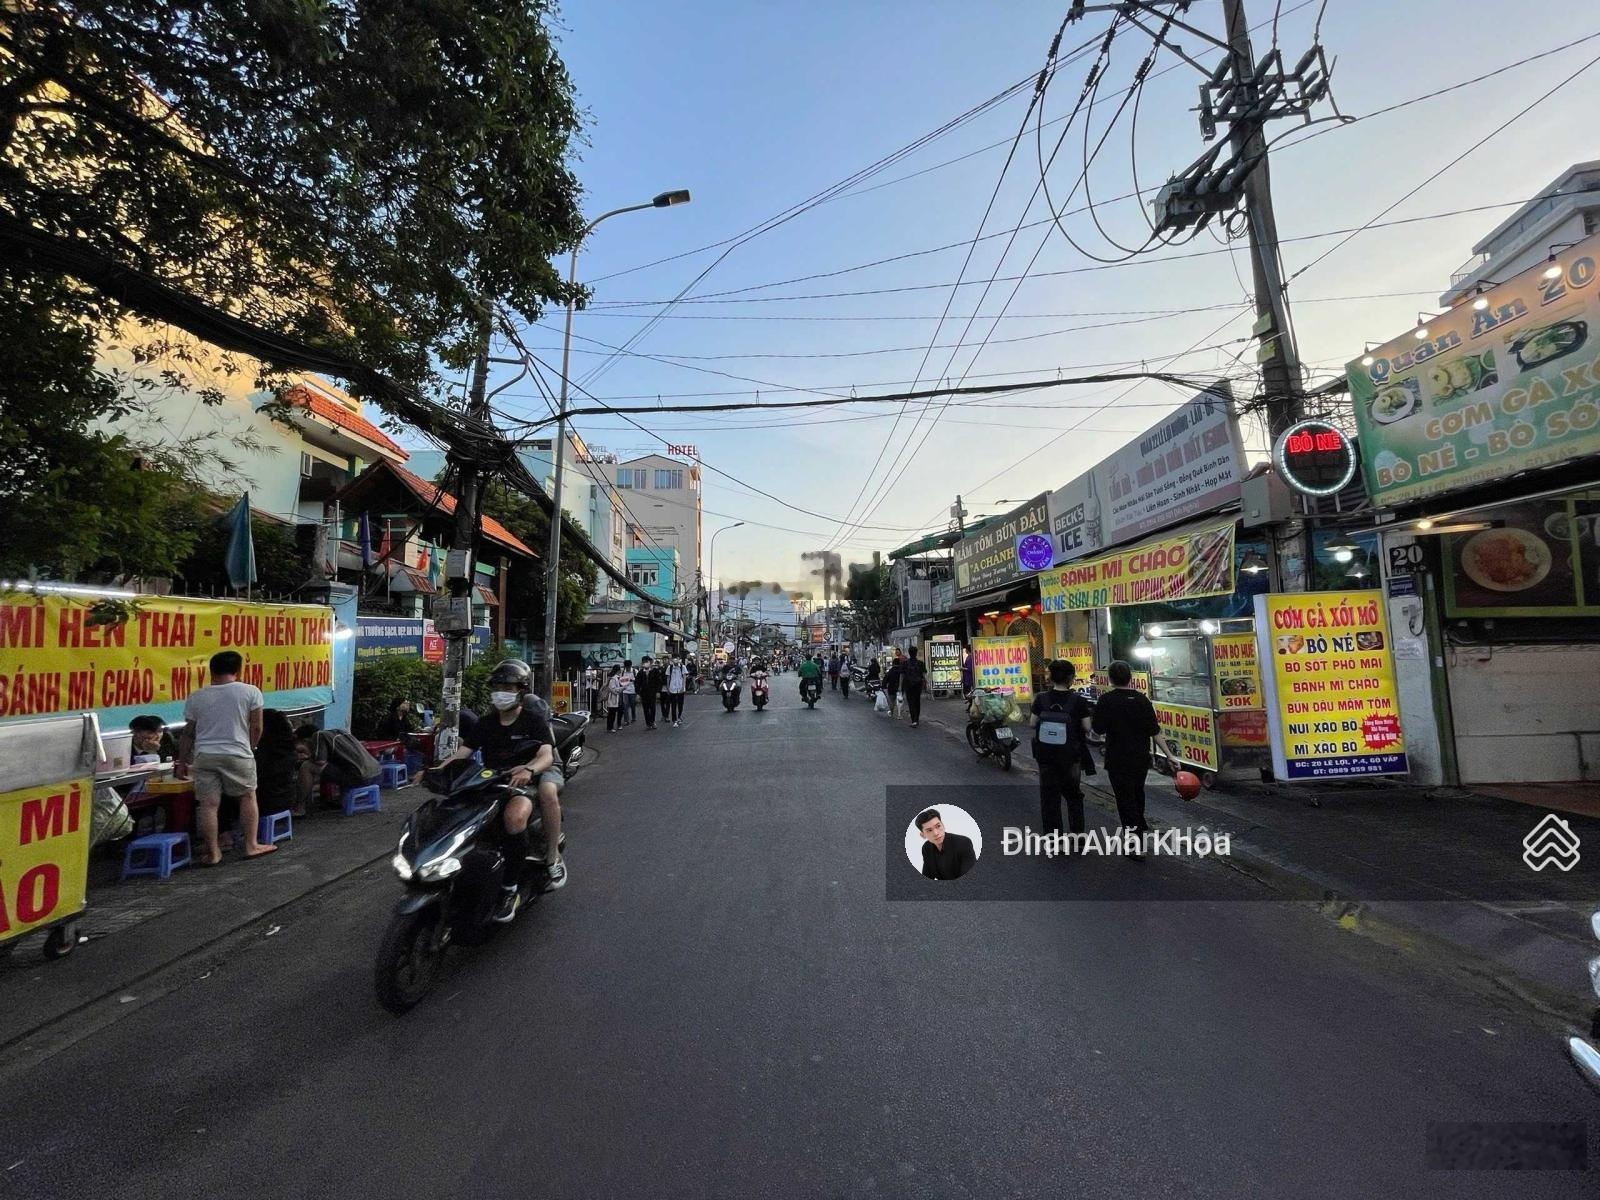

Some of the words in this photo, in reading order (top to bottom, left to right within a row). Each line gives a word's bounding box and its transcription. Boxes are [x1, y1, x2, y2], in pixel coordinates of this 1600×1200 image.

[1537, 256, 1596, 306] 20
[667, 444, 698, 456] HOTEL
[996, 521, 1017, 543] BÚN
[1019, 505, 1047, 532] ĐẬU
[1055, 506, 1084, 532] BECK'S
[1060, 526, 1083, 553] ICE
[1392, 545, 1424, 567] 20
[1112, 583, 1129, 604] FULL
[1130, 575, 1165, 601] TOPPING
[220, 608, 259, 647] BÚN
[1306, 634, 1328, 654] BÒ
[1332, 632, 1355, 653] NÉ
[1360, 657, 1383, 669] MAI
[68, 662, 96, 711] MÌ
[102, 656, 154, 707] CHẢO
[275, 657, 290, 691] MÌ
[293, 656, 314, 690] XÀO
[316, 653, 330, 687] BÒ
[1225, 697, 1252, 707] 30K
[1175, 711, 1188, 729] BÒ
[1191, 712, 1211, 733] HUẾ
[1289, 723, 1309, 734] NUI
[1184, 745, 1211, 765] 30K
[20, 783, 81, 847] MÌ
